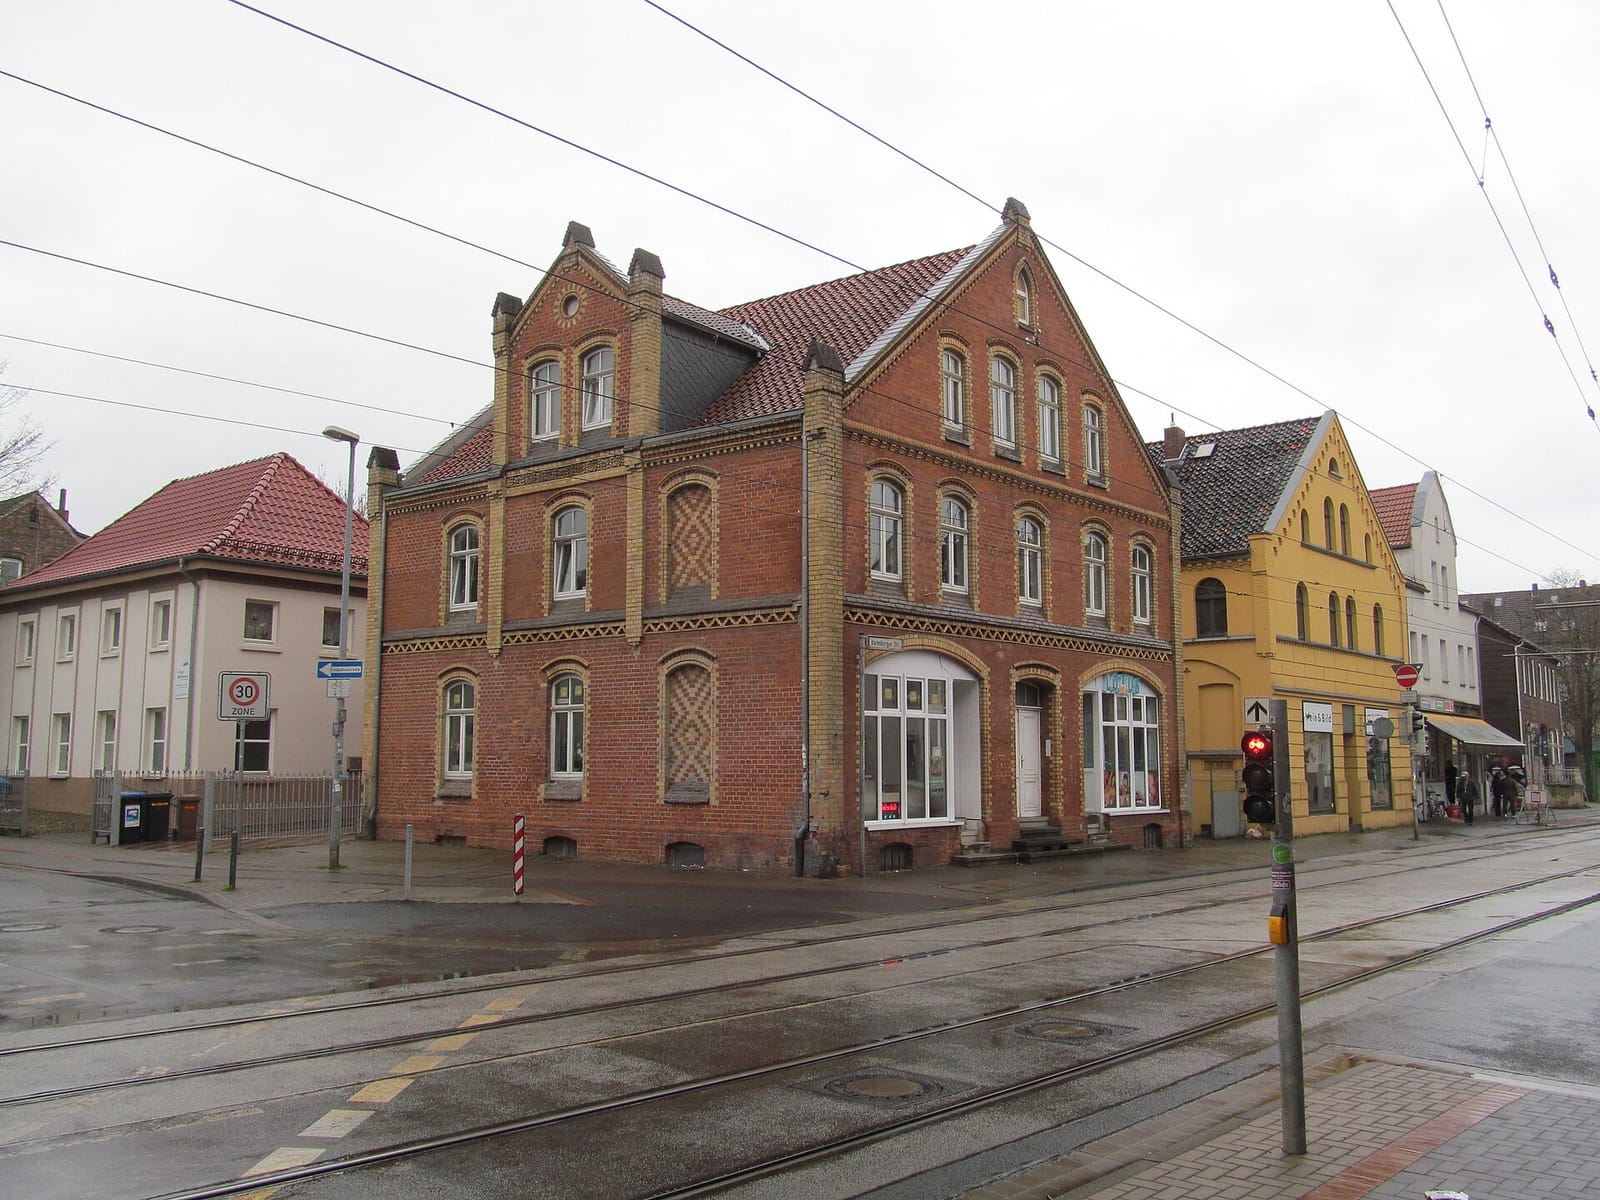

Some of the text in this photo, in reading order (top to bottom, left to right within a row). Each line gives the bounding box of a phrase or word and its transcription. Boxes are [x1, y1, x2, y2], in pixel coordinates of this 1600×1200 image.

[1104, 673, 1140, 693] LOTUS
[235, 685, 253, 699] 30
[232, 707, 255, 715] ZONE
